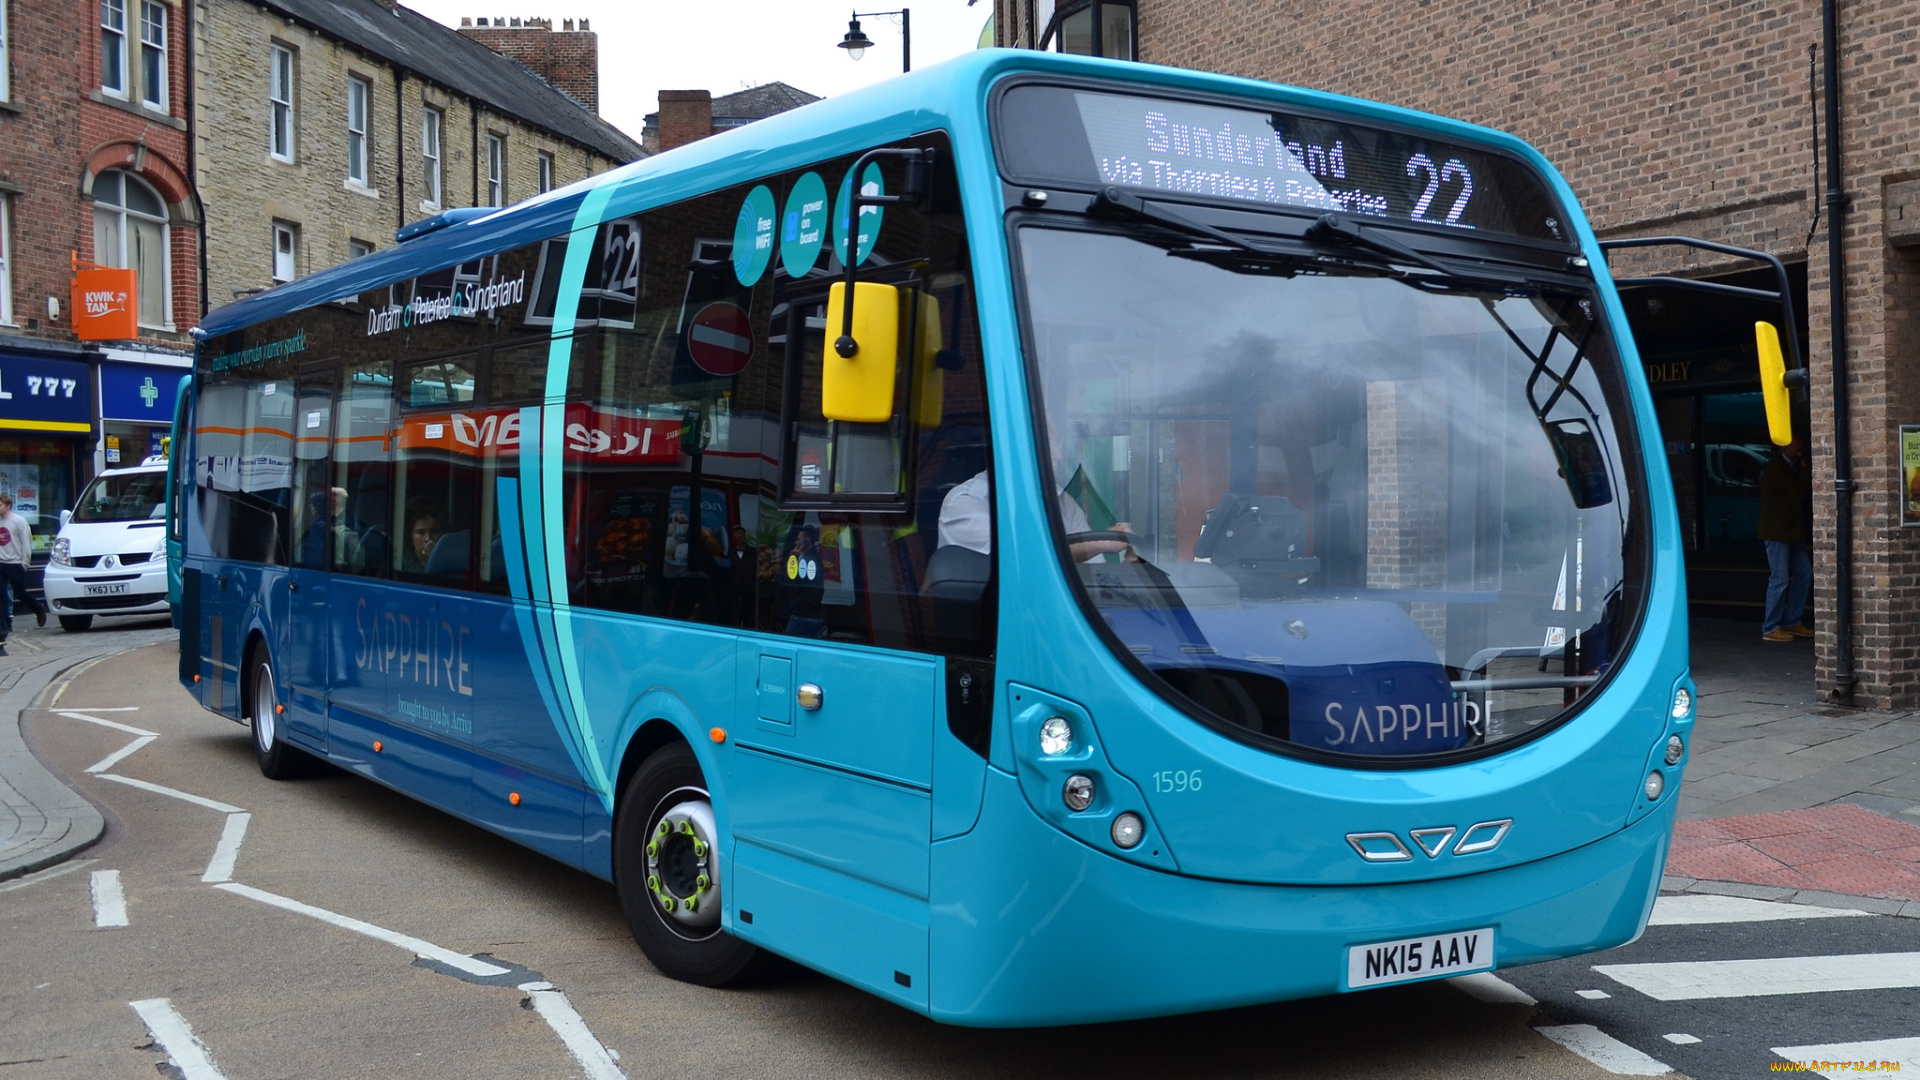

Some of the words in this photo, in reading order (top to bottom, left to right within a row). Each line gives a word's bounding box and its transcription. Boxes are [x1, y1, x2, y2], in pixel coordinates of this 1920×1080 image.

[1145, 110, 1346, 179] Sunderland
[1102, 155, 1142, 186] via
[1148, 159, 1259, 200] Thornley
[1285, 178, 1388, 219] Peterlee
[1406, 152, 1476, 230] 22
[802, 200, 823, 217] power
[757, 217, 772, 232] free
[801, 218, 811, 229] on
[755, 232, 771, 250] WiFi
[800, 229, 819, 245] board
[607, 231, 641, 293] 22
[85, 291, 115, 303] KWIK
[86, 302, 109, 313] TAN
[367, 305, 400, 336] Durham
[413, 291, 450, 326] Peterlee
[463, 270, 525, 315] Sunderland
[1644, 361, 1690, 383] DLEY
[27, 375, 77, 398] 777
[87, 585, 108, 594] YK63
[109, 584, 126, 593] LXT
[355, 598, 473, 696] SAPPHIRE
[397, 694, 421, 723] brought
[422, 705, 430, 721] to
[451, 711, 473, 735] Arriva
[1152, 770, 1202, 793] 1596
[1365, 942, 1423, 979] NK15
[1430, 934, 1478, 970] AAV
